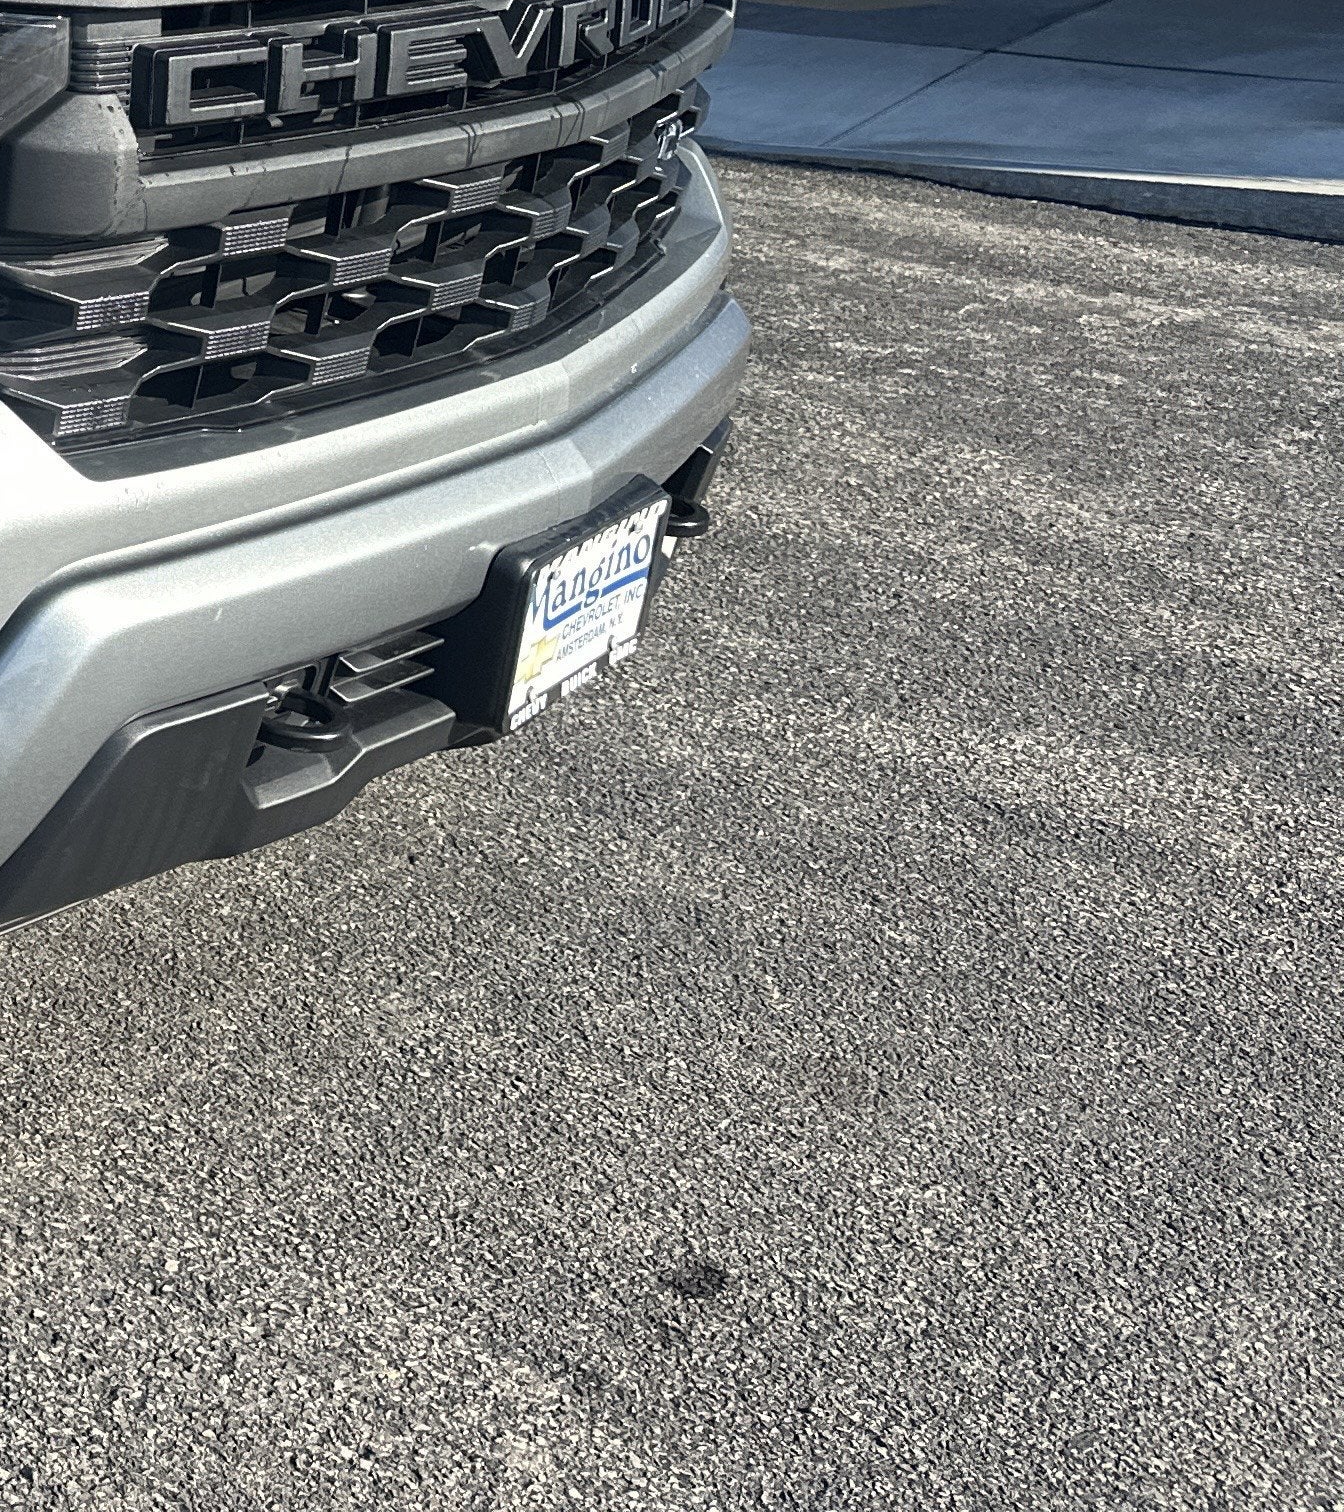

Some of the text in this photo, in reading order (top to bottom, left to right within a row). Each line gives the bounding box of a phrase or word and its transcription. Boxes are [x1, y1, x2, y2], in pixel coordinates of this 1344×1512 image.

[529, 534, 651, 631] Mangino
[510, 638, 638, 730] CHEVY BUICK GMC
